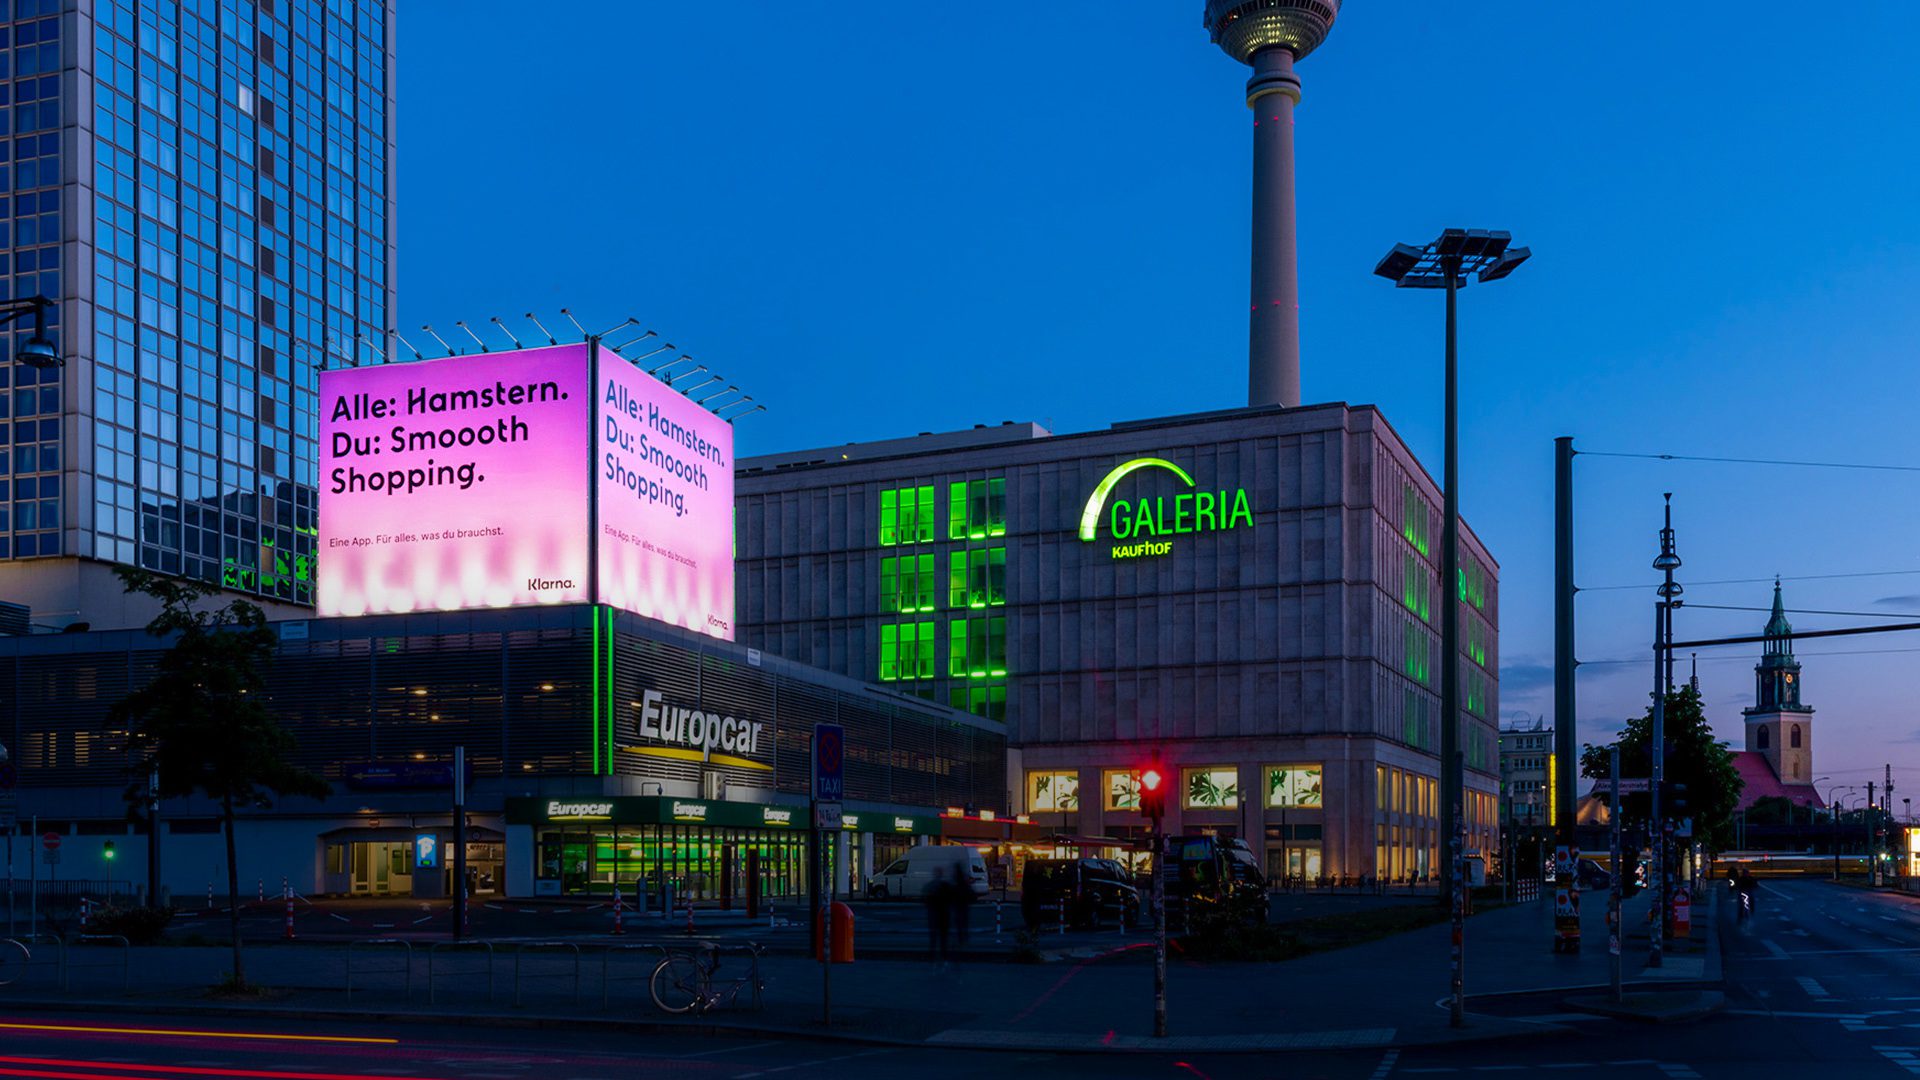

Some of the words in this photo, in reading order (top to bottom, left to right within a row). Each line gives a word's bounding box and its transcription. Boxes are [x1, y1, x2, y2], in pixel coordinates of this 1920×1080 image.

[331, 394, 397, 422] Alle:
[408, 381, 569, 415] Hamstern.
[332, 431, 380, 458] Du:
[391, 415, 529, 452] Smoooth
[605, 379, 643, 422] Alle:
[649, 402, 725, 468] Hamstern.
[605, 415, 635, 452] Du:
[640, 438, 708, 491] Smoooth
[331, 459, 485, 495] Shopping.
[605, 453, 688, 517] Shopping.
[1111, 488, 1254, 539] GALERIA
[329, 538, 349, 548] Eine
[352, 537, 373, 547] App.
[376, 535, 391, 544] Für
[394, 533, 418, 543] alles,
[421, 533, 440, 541] was
[442, 530, 454, 539] du
[457, 527, 503, 538] brauchst.
[528, 576, 575, 591] Klarna.
[639, 689, 762, 762] Europcar
[819, 777, 841, 793] TAXI
[548, 802, 613, 818] Europcar
[673, 801, 707, 818] Europcar
